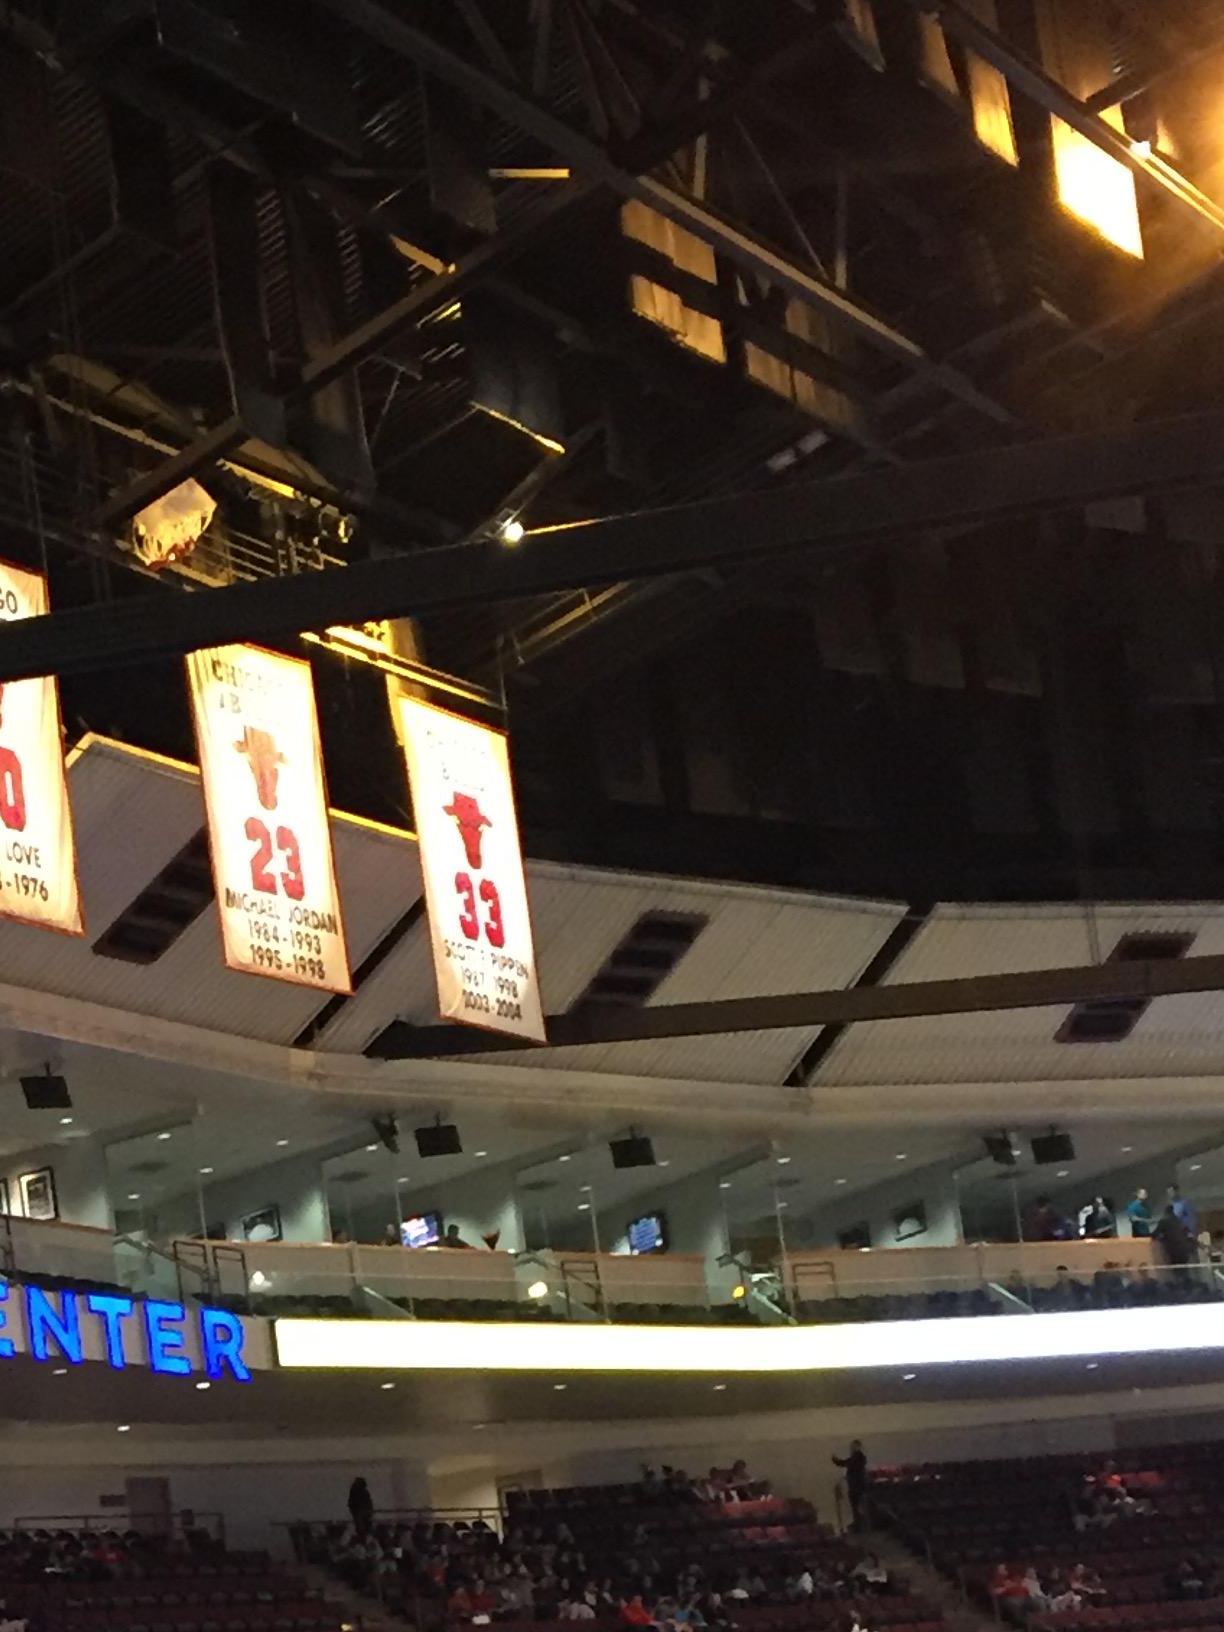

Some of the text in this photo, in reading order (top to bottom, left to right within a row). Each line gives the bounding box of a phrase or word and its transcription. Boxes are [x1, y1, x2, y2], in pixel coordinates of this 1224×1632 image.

[5, 839, 42, 870] LOVE
[244, 816, 305, 901] 23
[289, 905, 338, 936] JORDAN
[455, 871, 506, 949] 33
[250, 943, 326, 980] 1995-1998
